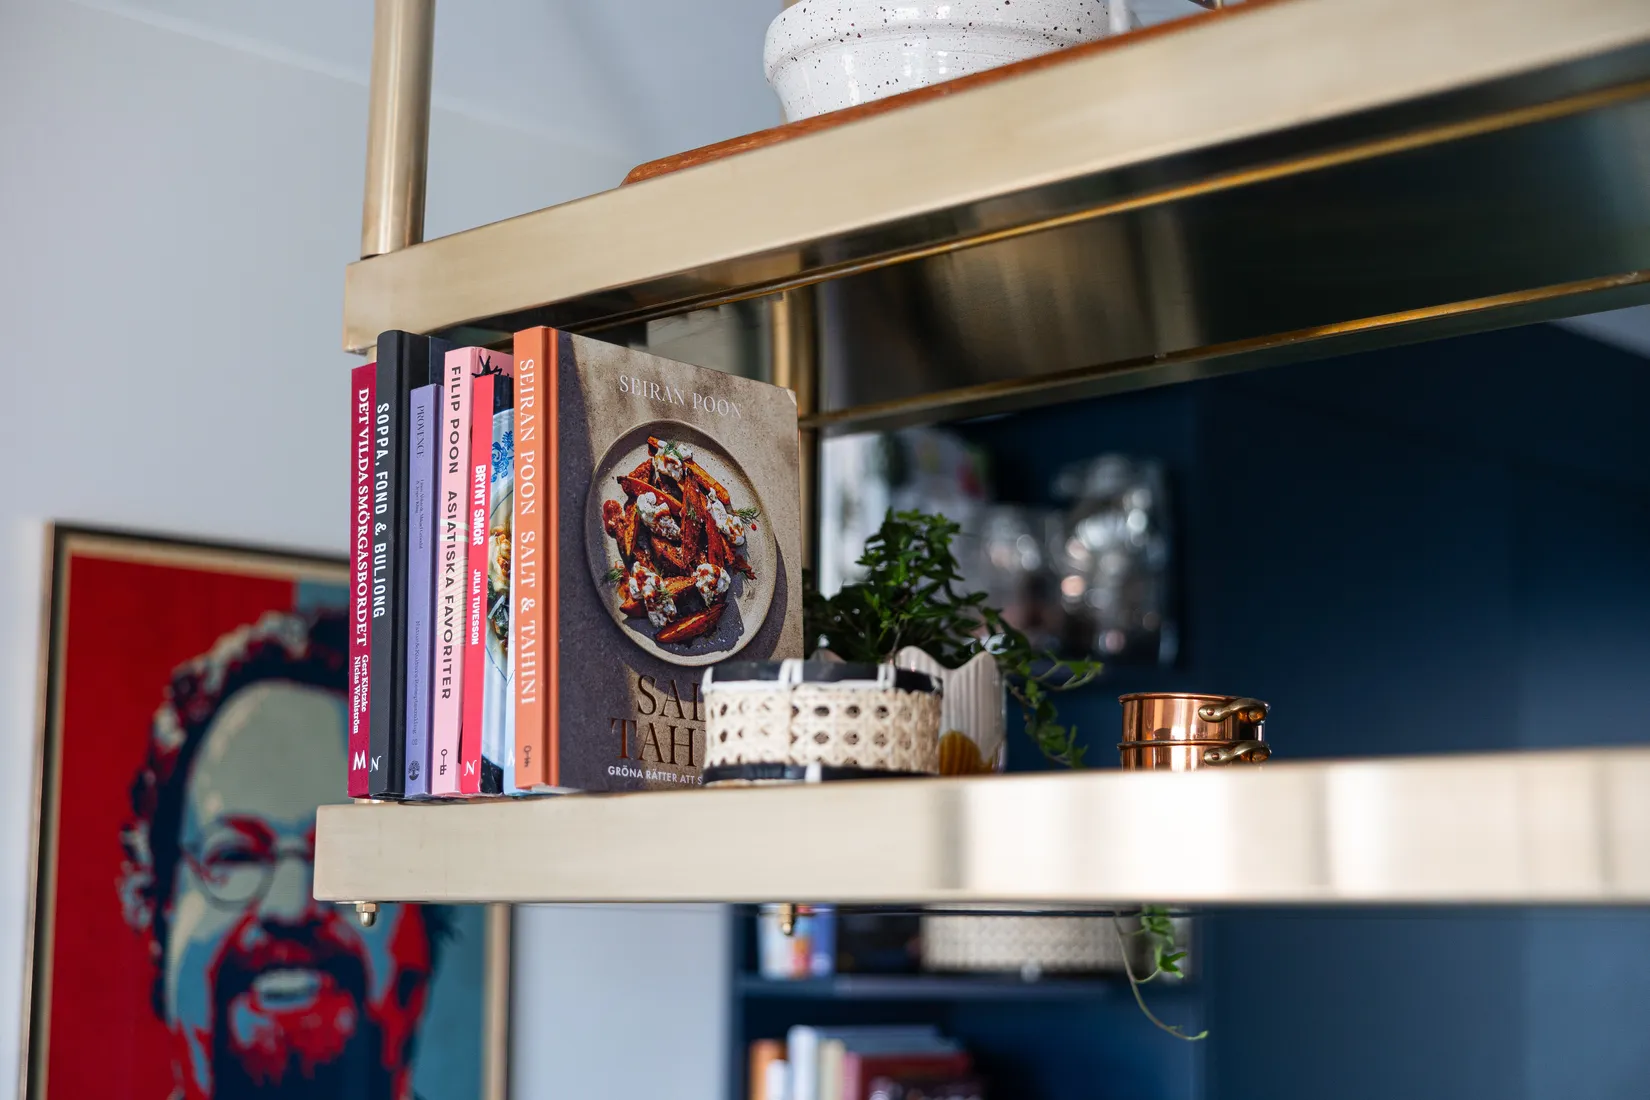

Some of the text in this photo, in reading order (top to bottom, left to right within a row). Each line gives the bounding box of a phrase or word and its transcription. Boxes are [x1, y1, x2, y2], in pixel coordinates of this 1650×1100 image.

[449, 366, 461, 473] FILIP POON
[520, 359, 535, 515] SEIRAN POON
[620, 374, 741, 418] SEIRAN POON
[356, 388, 370, 646] DET VILDA SMÖRGÅSBORDET
[373, 403, 389, 618] SOPPA, FOND & BULJONG
[474, 464, 486, 506] BRYNT
[442, 491, 457, 699] ASIATISKA FAVORITER
[472, 569, 481, 646] JULIA TUVESSON
[521, 531, 536, 704] SALT & TAHINI
[353, 684, 361, 734] Wahlström
[637, 675, 706, 722] SAL
[608, 765, 703, 785] GRÖNA RÄTTER ATT S
